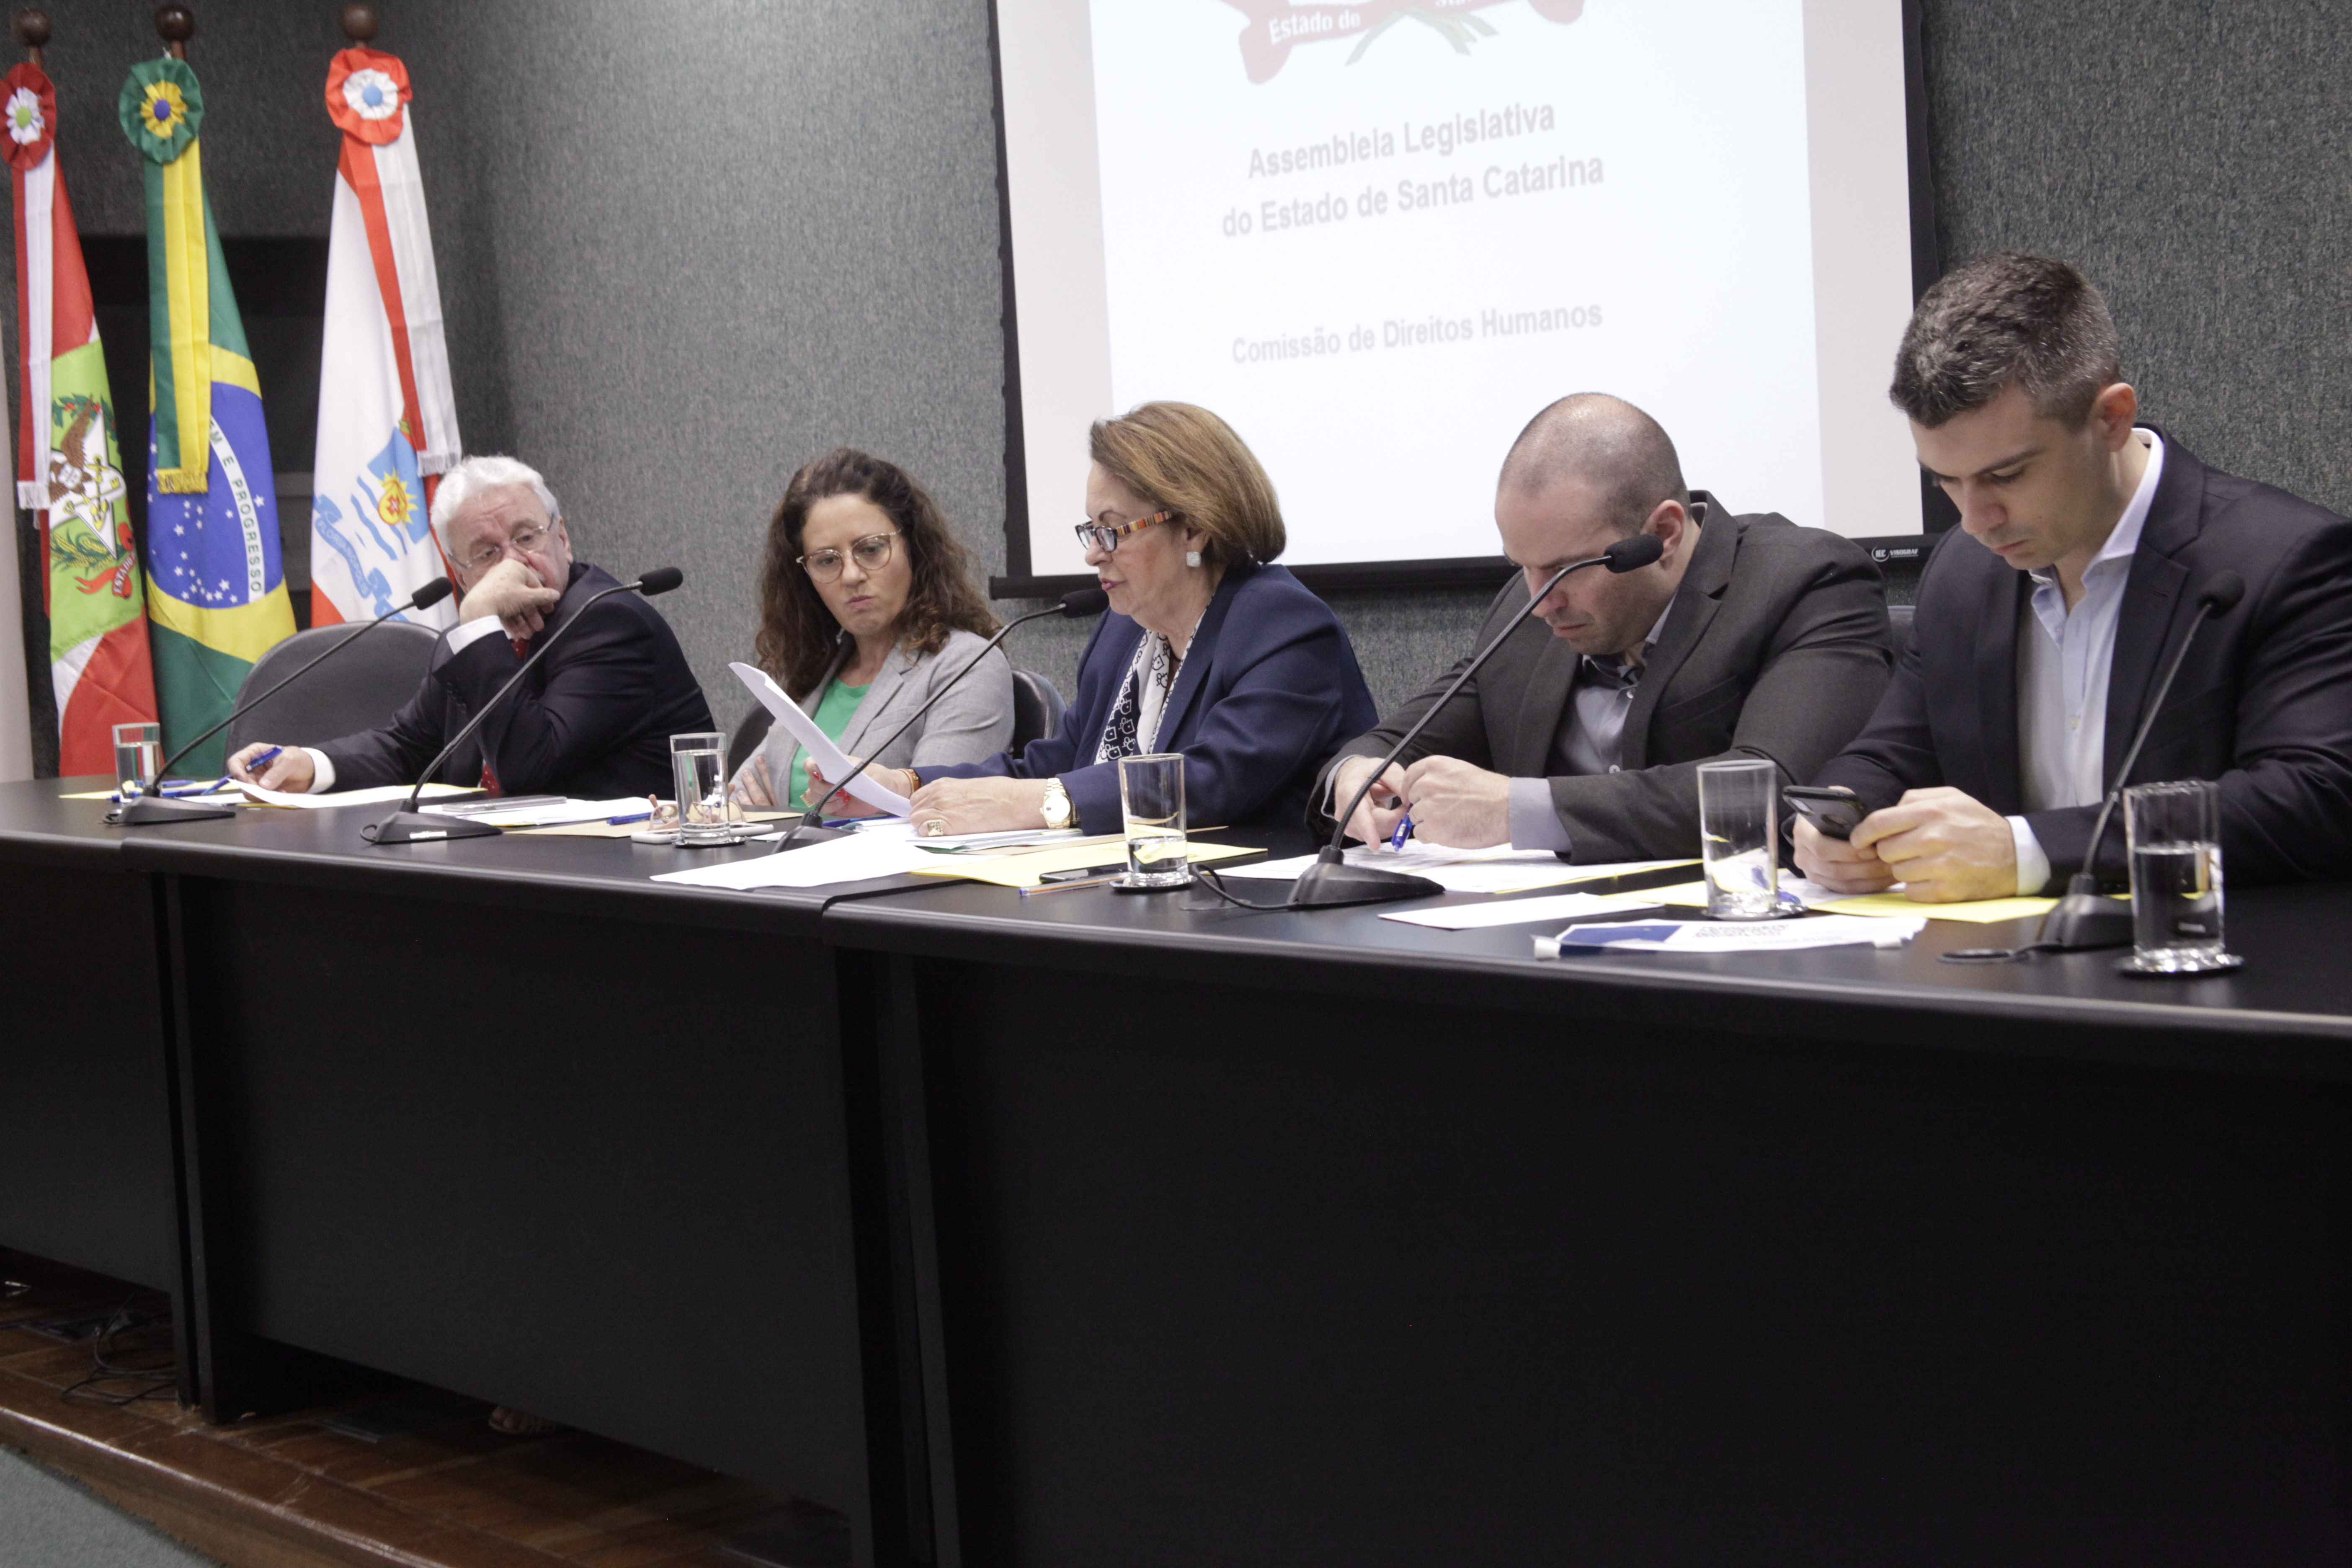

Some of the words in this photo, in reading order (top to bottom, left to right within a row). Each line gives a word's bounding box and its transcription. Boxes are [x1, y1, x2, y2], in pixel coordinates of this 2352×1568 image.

[1268, 11, 1333, 45] Estado
[1338, 9, 1362, 29] de
[1248, 127, 1395, 179] Assembleia
[1404, 102, 1555, 157] Legislativa
[1222, 206, 1252, 237] do
[1261, 191, 1348, 232] Estado
[1357, 185, 1388, 217] de
[1397, 173, 1474, 211] Santa
[1483, 154, 1604, 199] Catarina
[1232, 326, 1341, 364] Comissão
[1348, 324, 1375, 351] de
[1382, 315, 1474, 348] Direitos
[1481, 304, 1603, 338] Humanos
[232, 479, 262, 592] PROGRESSO
